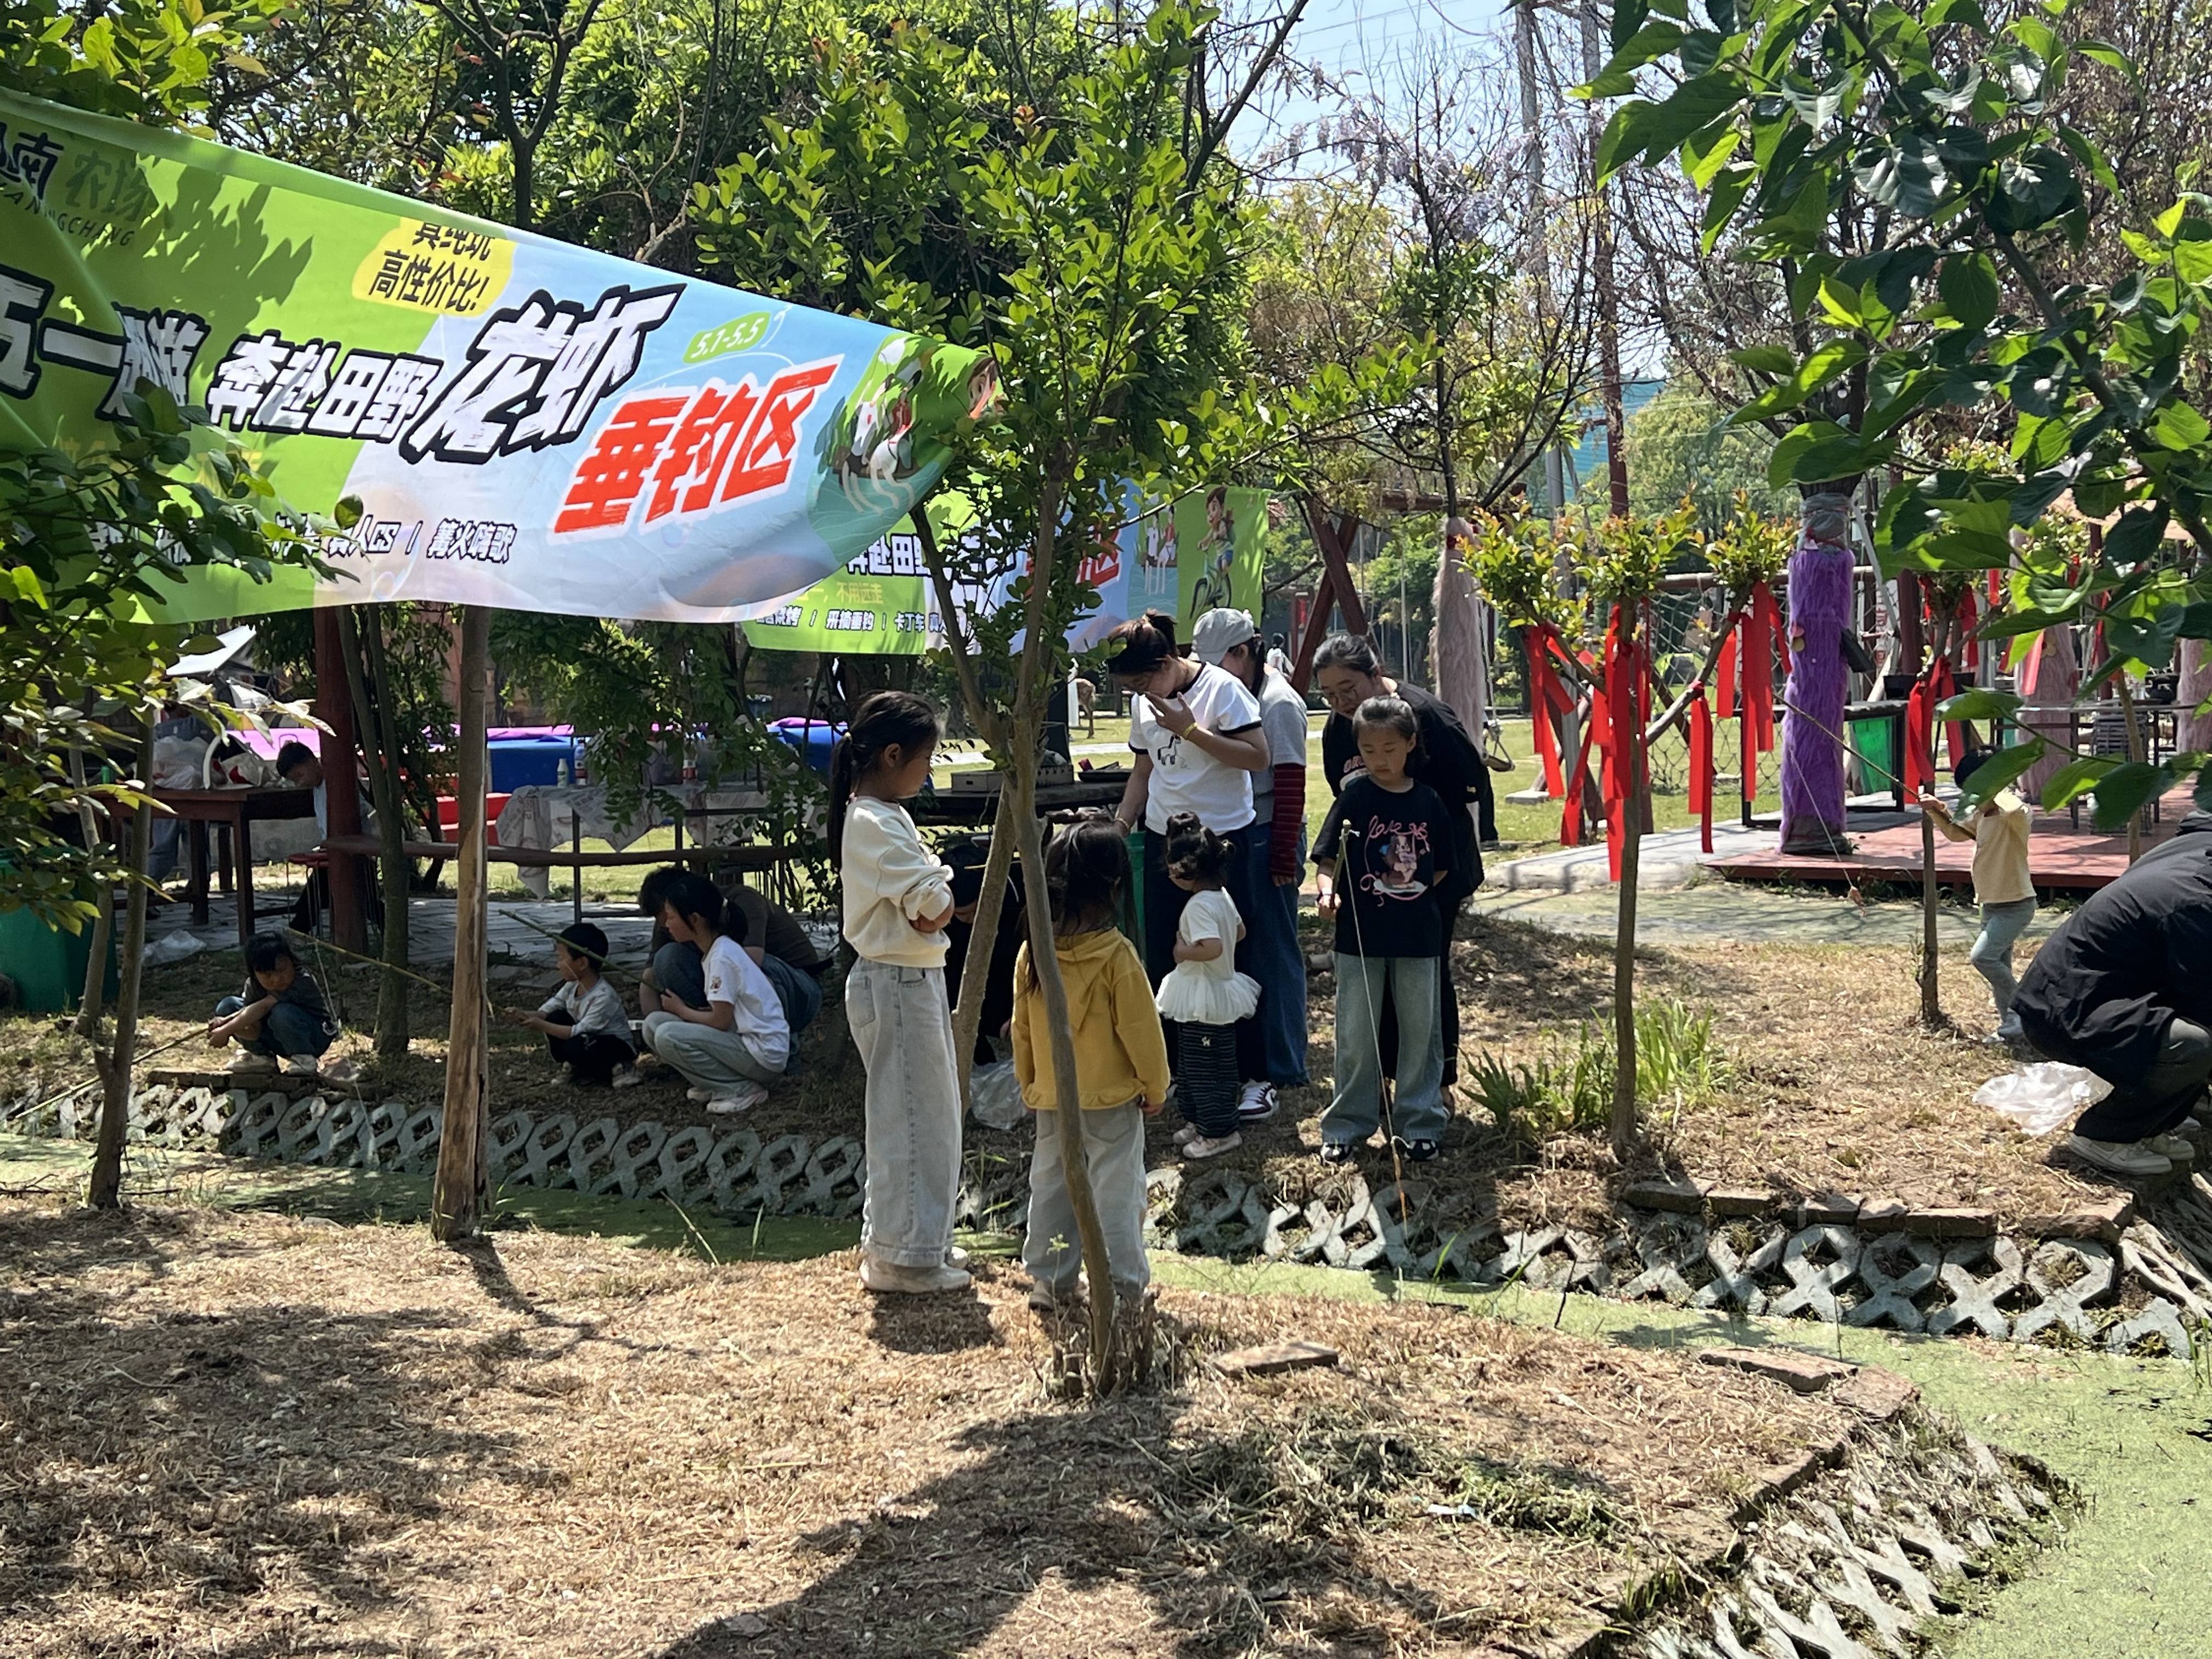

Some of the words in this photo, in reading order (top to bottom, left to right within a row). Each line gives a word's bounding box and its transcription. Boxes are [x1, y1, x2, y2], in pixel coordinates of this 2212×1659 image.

[0, 122, 149, 222] 南农场
[690, 317, 765, 359] 5.1-5.5
[205, 329, 443, 443] 奔赴田野
[399, 282, 688, 465] 龙虾
[553, 363, 839, 534] 垂钓区
[894, 611, 926, 633] 卡丁车
